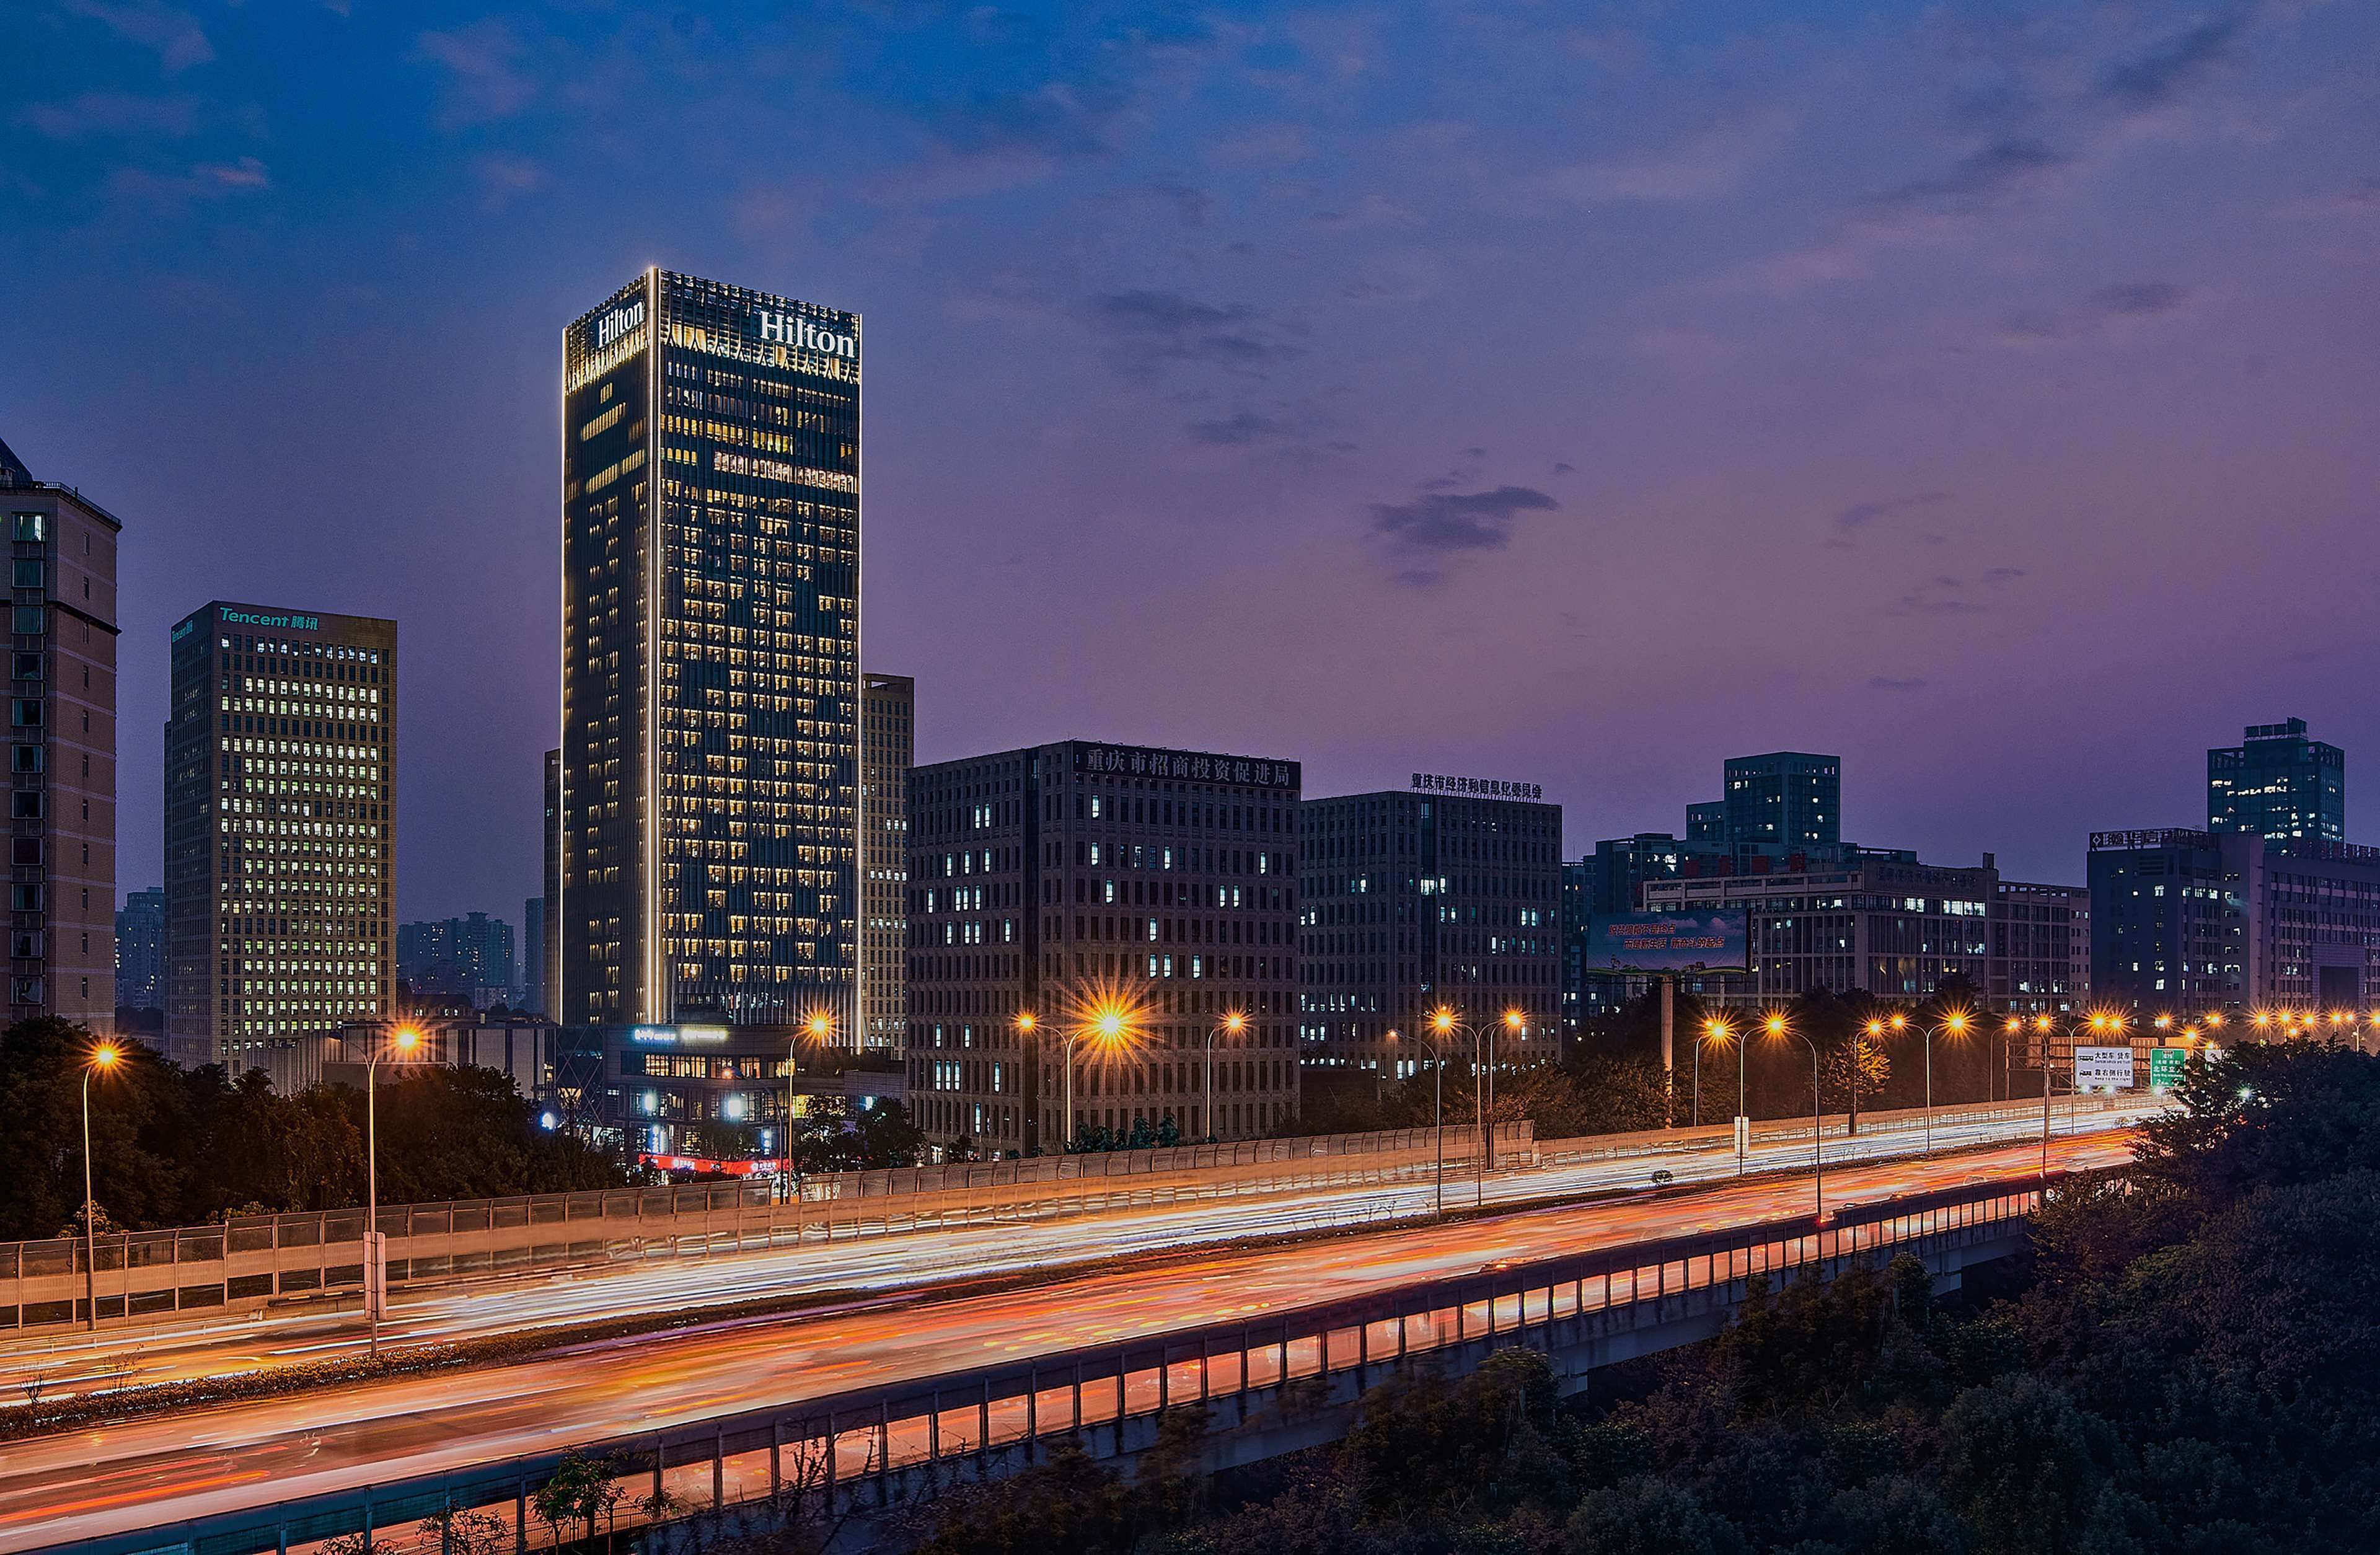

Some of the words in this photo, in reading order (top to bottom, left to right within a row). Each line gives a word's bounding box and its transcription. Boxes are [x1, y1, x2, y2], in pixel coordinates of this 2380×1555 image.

[598, 300, 643, 348] Hilton
[760, 311, 854, 358] Hilton
[219, 607, 289, 628] Tencent
[291, 615, 319, 631] 腾讯
[1086, 748, 1290, 786] 重庆市招商投资促进局
[1411, 773, 1542, 800] 重庆市经济和信息化委员会
[1624, 937, 1667, 949] 而是新生活
[1670, 936, 1726, 949] 新奋斗的起点
